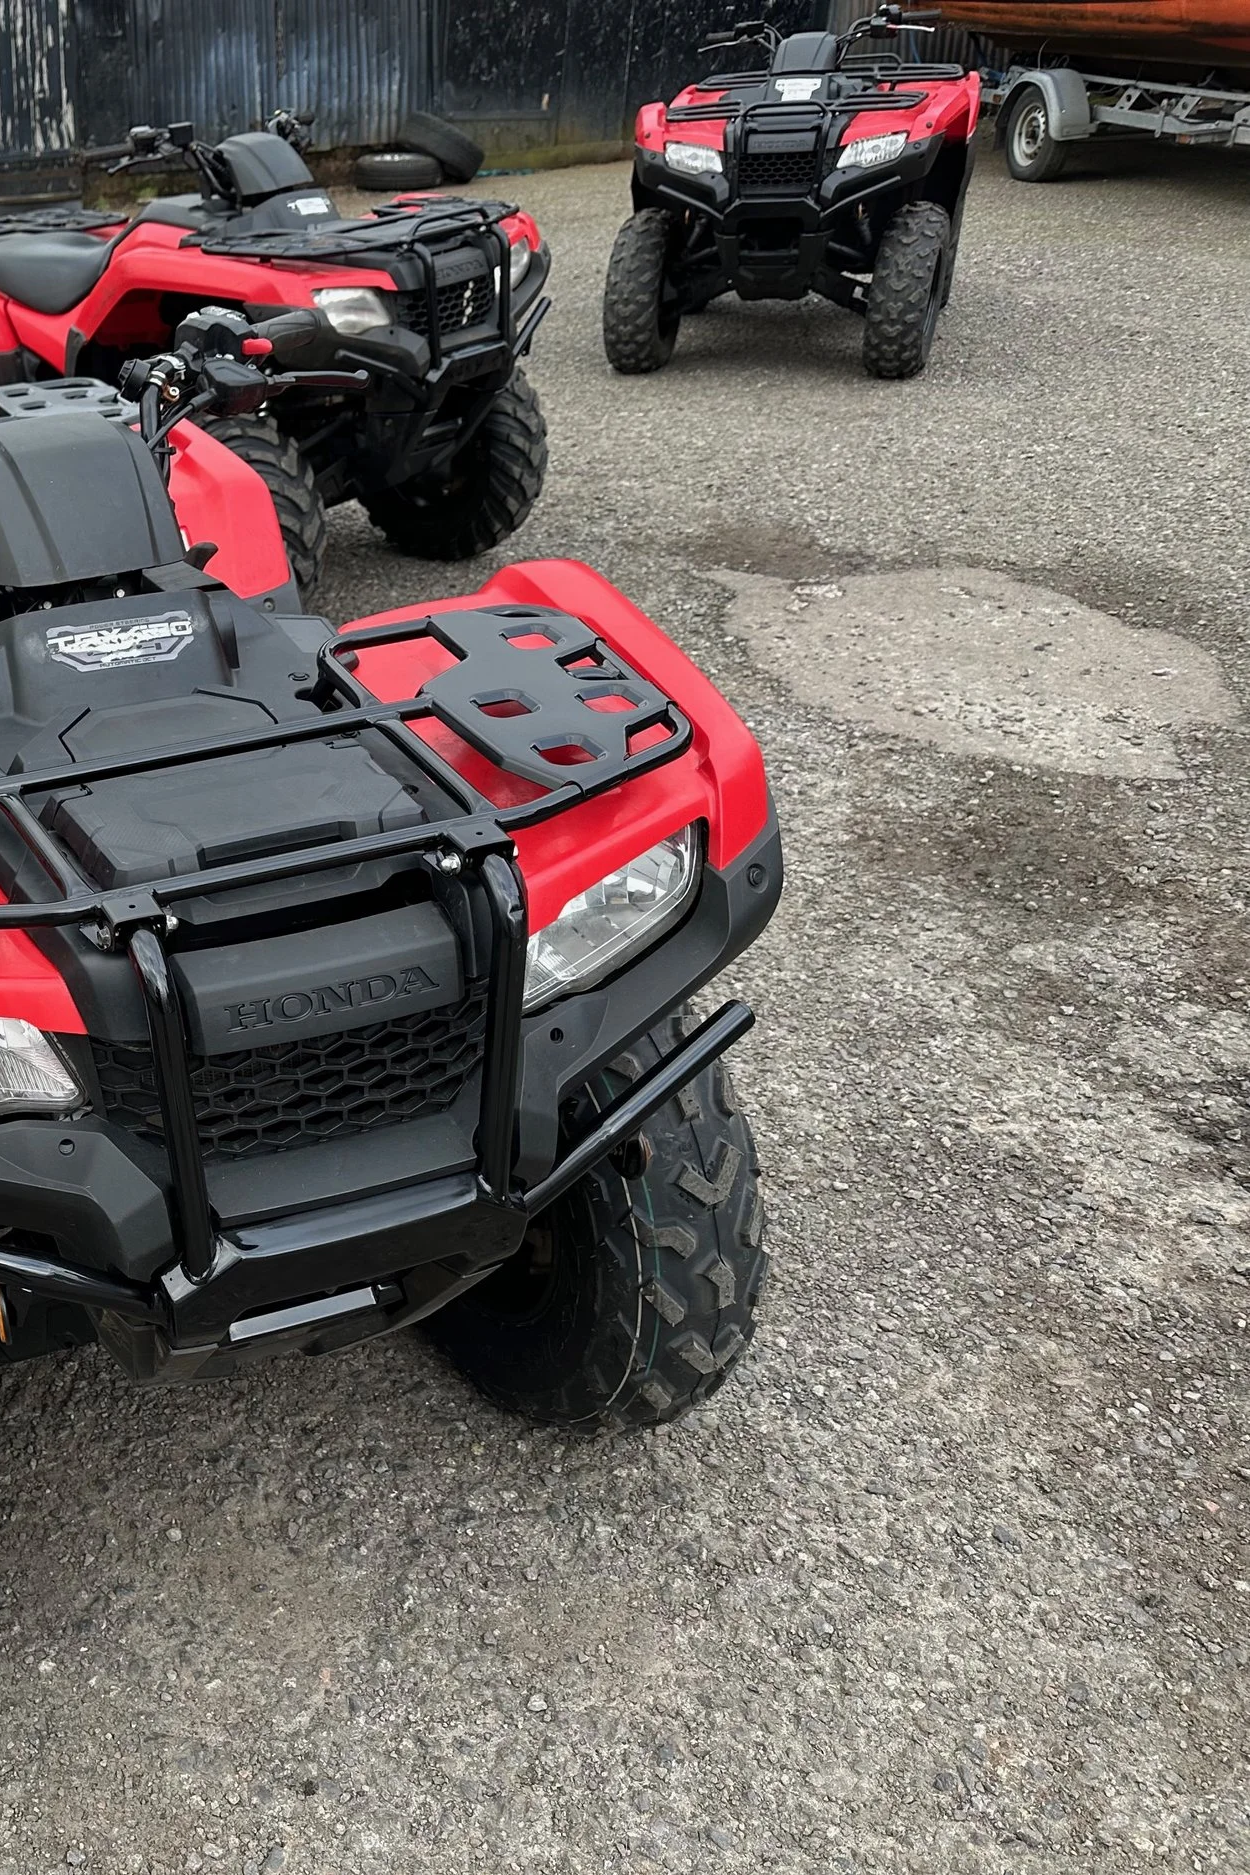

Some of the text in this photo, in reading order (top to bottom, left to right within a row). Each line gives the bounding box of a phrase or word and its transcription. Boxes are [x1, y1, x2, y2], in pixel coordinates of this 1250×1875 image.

[115, 617, 150, 627] STEERING
[99, 657, 141, 668] AUTOMATIC
[224, 966, 440, 1034] HONDA
